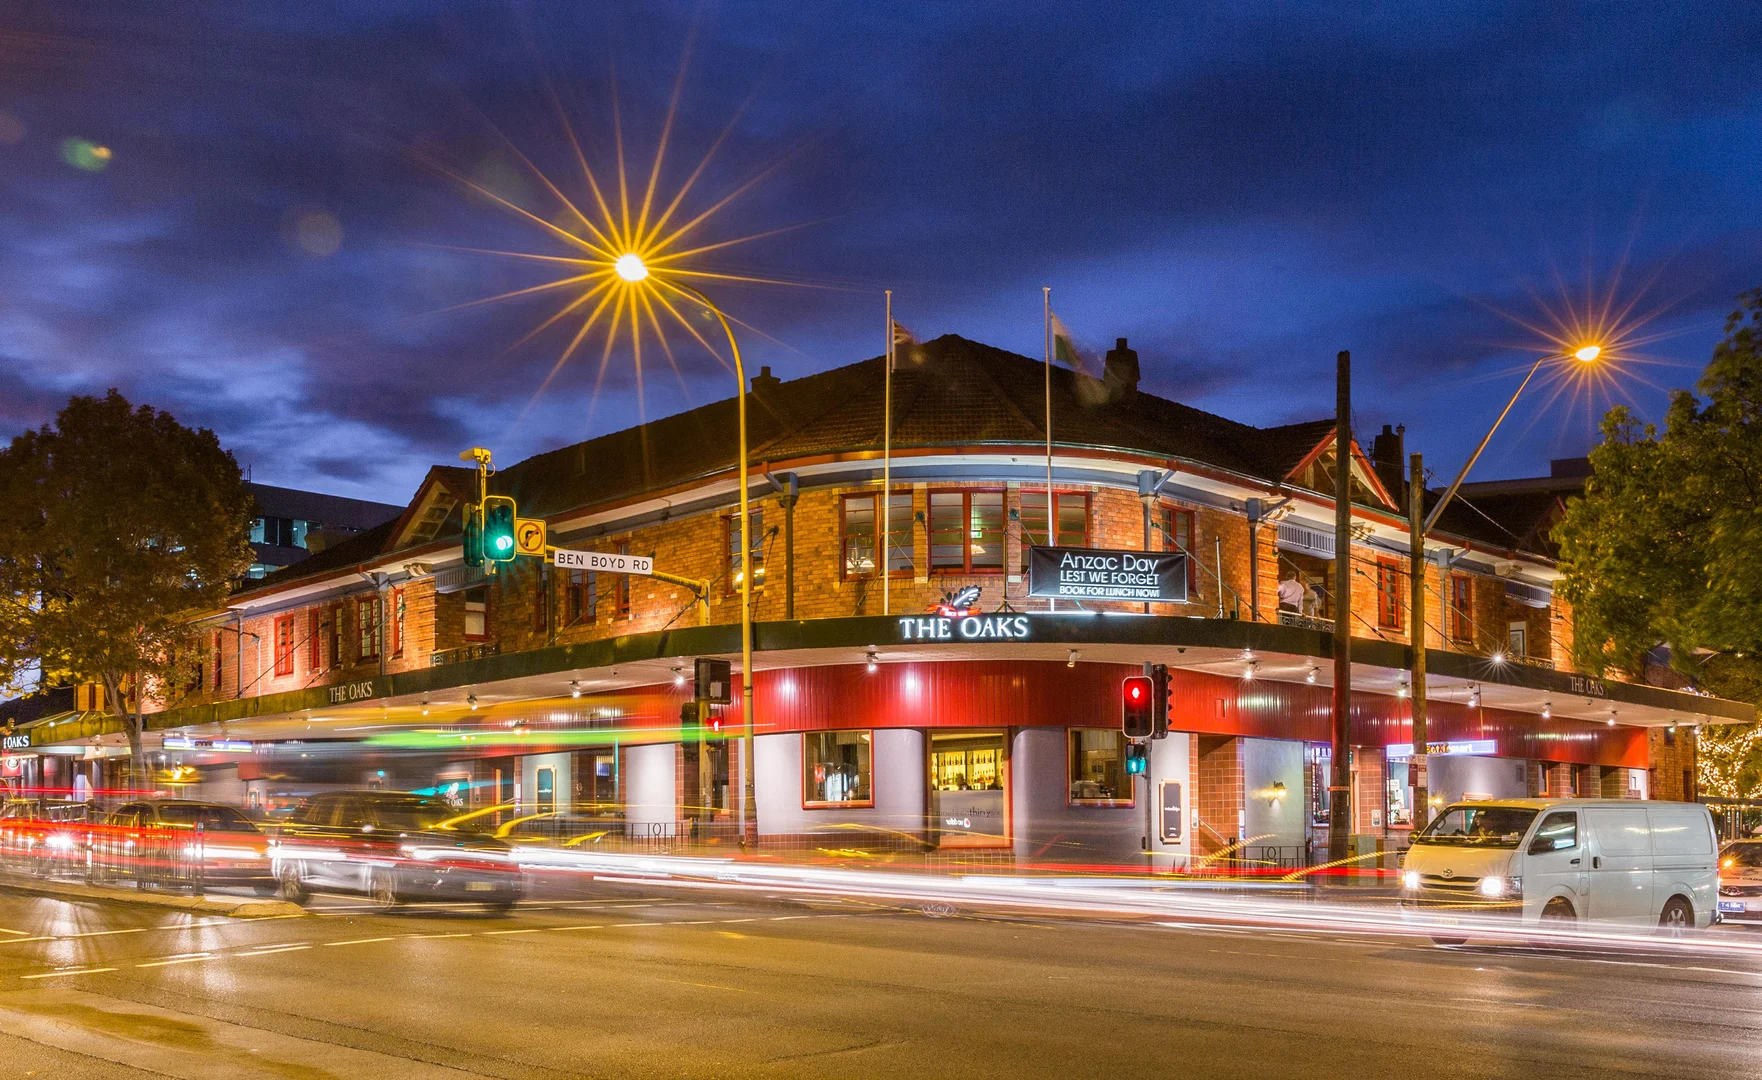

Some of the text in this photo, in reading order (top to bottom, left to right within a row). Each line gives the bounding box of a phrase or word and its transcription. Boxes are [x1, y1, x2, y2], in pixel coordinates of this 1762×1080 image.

[558, 553, 649, 571] BEN BOYD RD
[1060, 552, 1160, 576] Anzac Day
[1060, 570, 1160, 585] LEST WE FORGET
[1060, 586, 1160, 598] BOOK FOR LUNCH NOW!
[899, 617, 1029, 639] THE OAKS
[329, 681, 373, 702] THE OAKS
[1570, 676, 1584, 693] THE
[7, 735, 30, 749] OAKS
